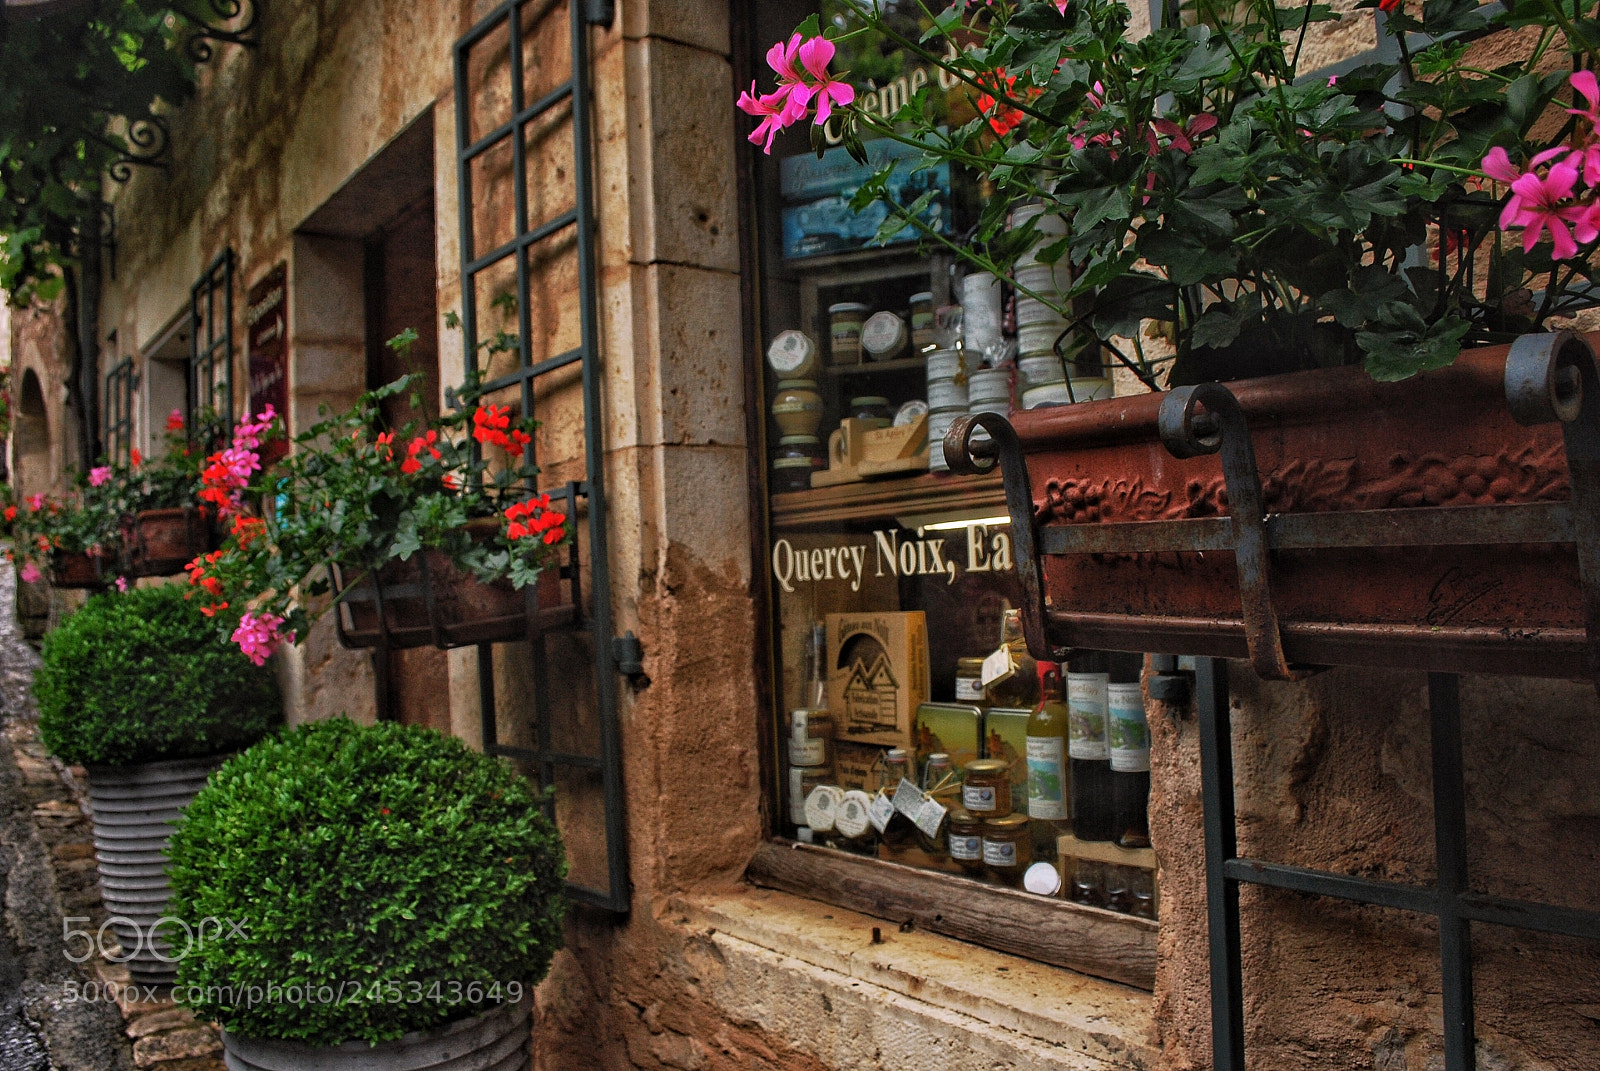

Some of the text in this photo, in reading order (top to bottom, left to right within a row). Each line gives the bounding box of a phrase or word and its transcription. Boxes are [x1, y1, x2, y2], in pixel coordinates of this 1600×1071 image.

[823, 67, 928, 146] Cème
[773, 538, 867, 592] Quercy
[873, 528, 956, 585] Noix,
